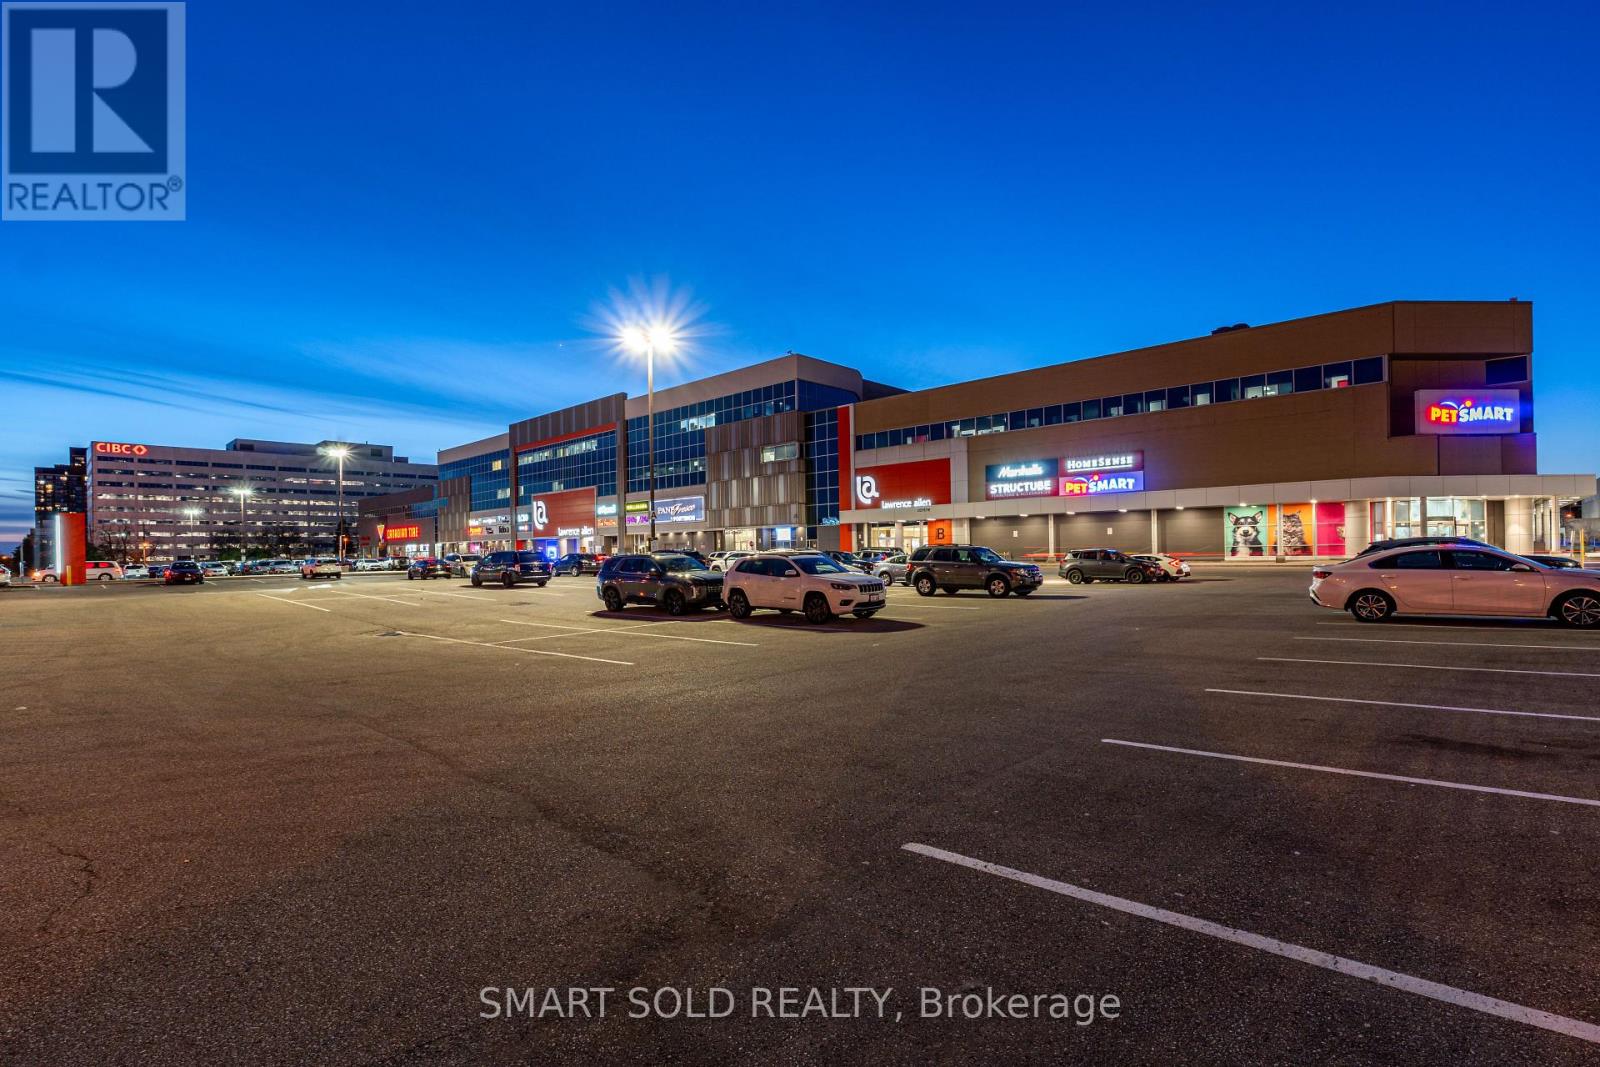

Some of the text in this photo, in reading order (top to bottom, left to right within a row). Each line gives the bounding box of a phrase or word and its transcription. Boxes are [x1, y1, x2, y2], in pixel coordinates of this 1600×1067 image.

[1430, 406, 1514, 423] PETSMART
[96, 442, 131, 455] CIBC
[990, 479, 1052, 495] STRUCTUBE
[1065, 477, 1135, 494] PETSMART
[881, 498, 932, 509] lawrence allen
[936, 527, 945, 540] B
